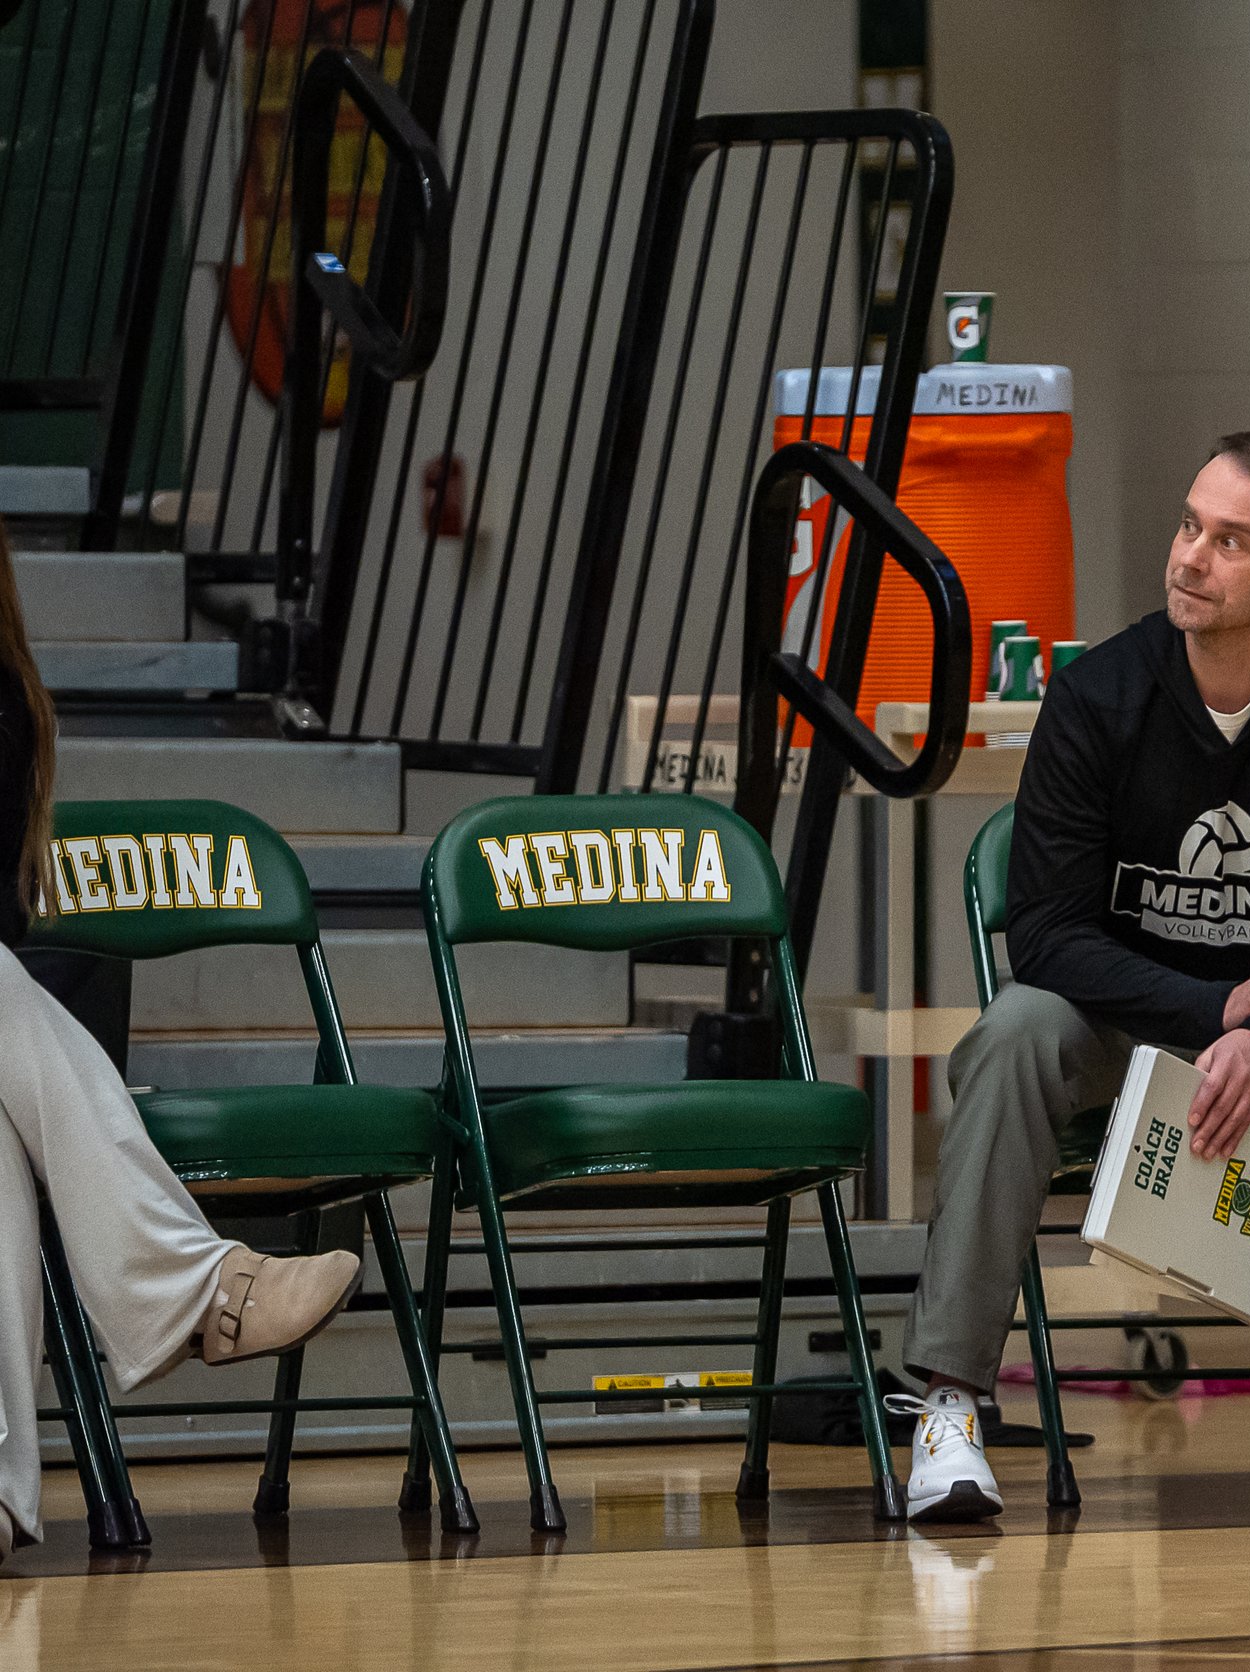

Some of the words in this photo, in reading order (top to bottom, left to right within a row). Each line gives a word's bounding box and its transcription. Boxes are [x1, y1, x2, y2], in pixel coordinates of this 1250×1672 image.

[947, 304, 980, 349] G
[478, 828, 731, 911] MEDINA
[1134, 1116, 1167, 1191] COACH
[1151, 1125, 1184, 1201] BRAGG
[1214, 1159, 1246, 1225] MEDINA
